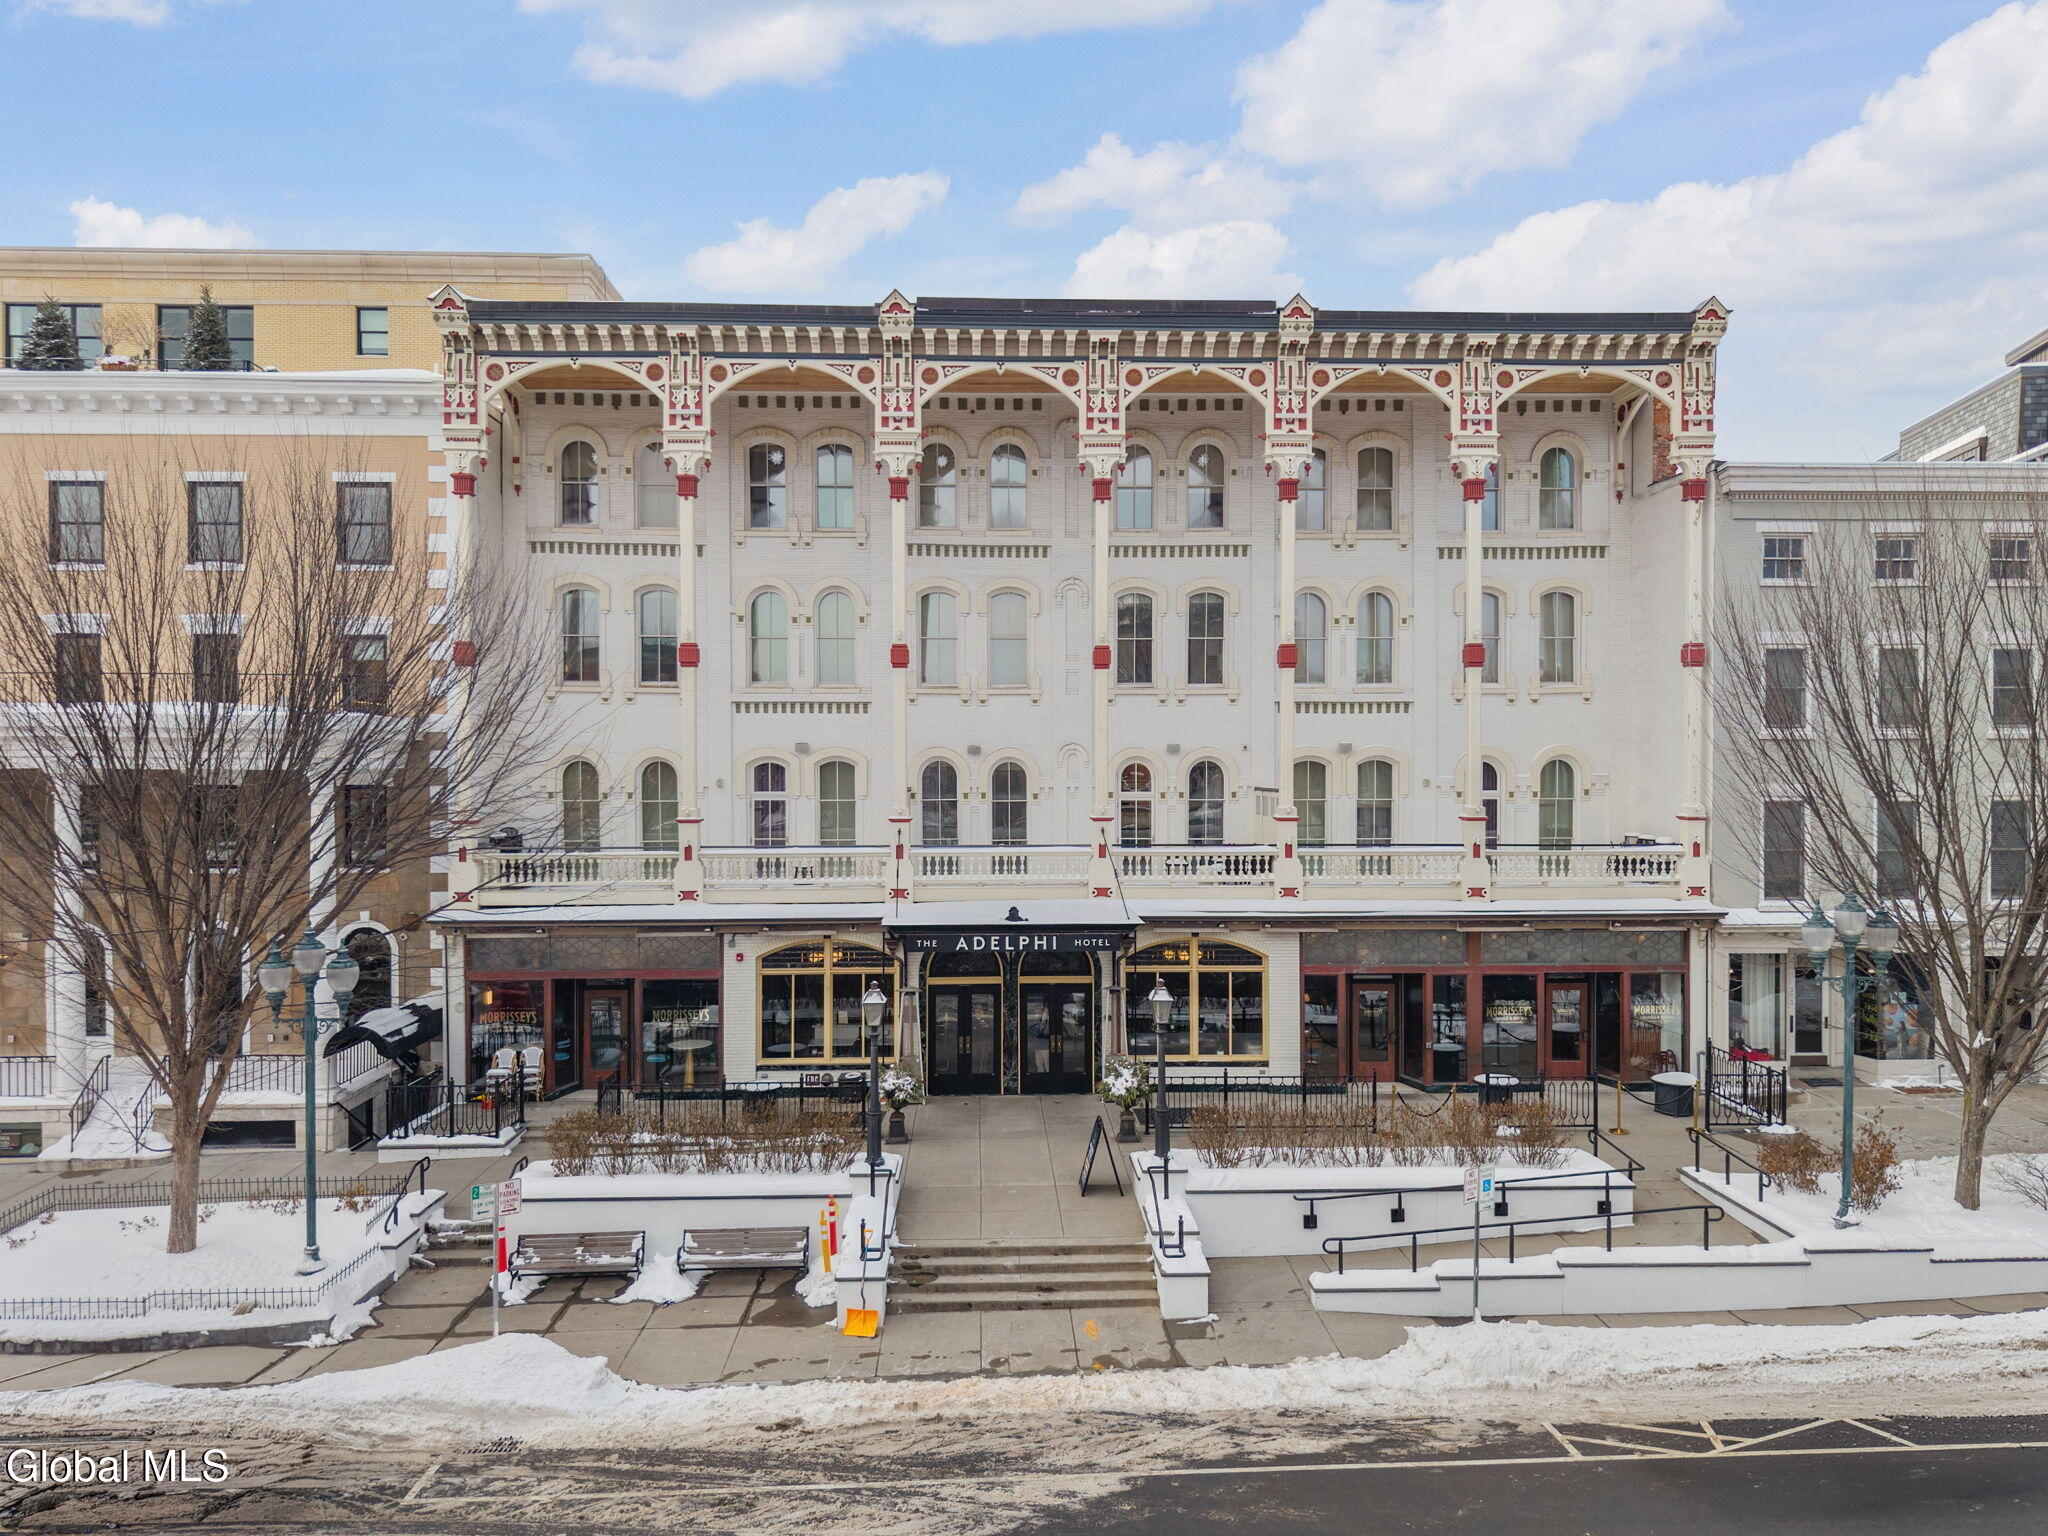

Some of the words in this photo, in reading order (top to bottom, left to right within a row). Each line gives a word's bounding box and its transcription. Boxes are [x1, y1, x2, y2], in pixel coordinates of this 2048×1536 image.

[916, 939, 938, 948] THE
[955, 935, 1058, 951] ADELPHI
[1074, 938, 1111, 947] HOTEL
[504, 1181, 515, 1189] NO
[473, 1189, 478, 1199] 2
[499, 1188, 520, 1198] PARKING
